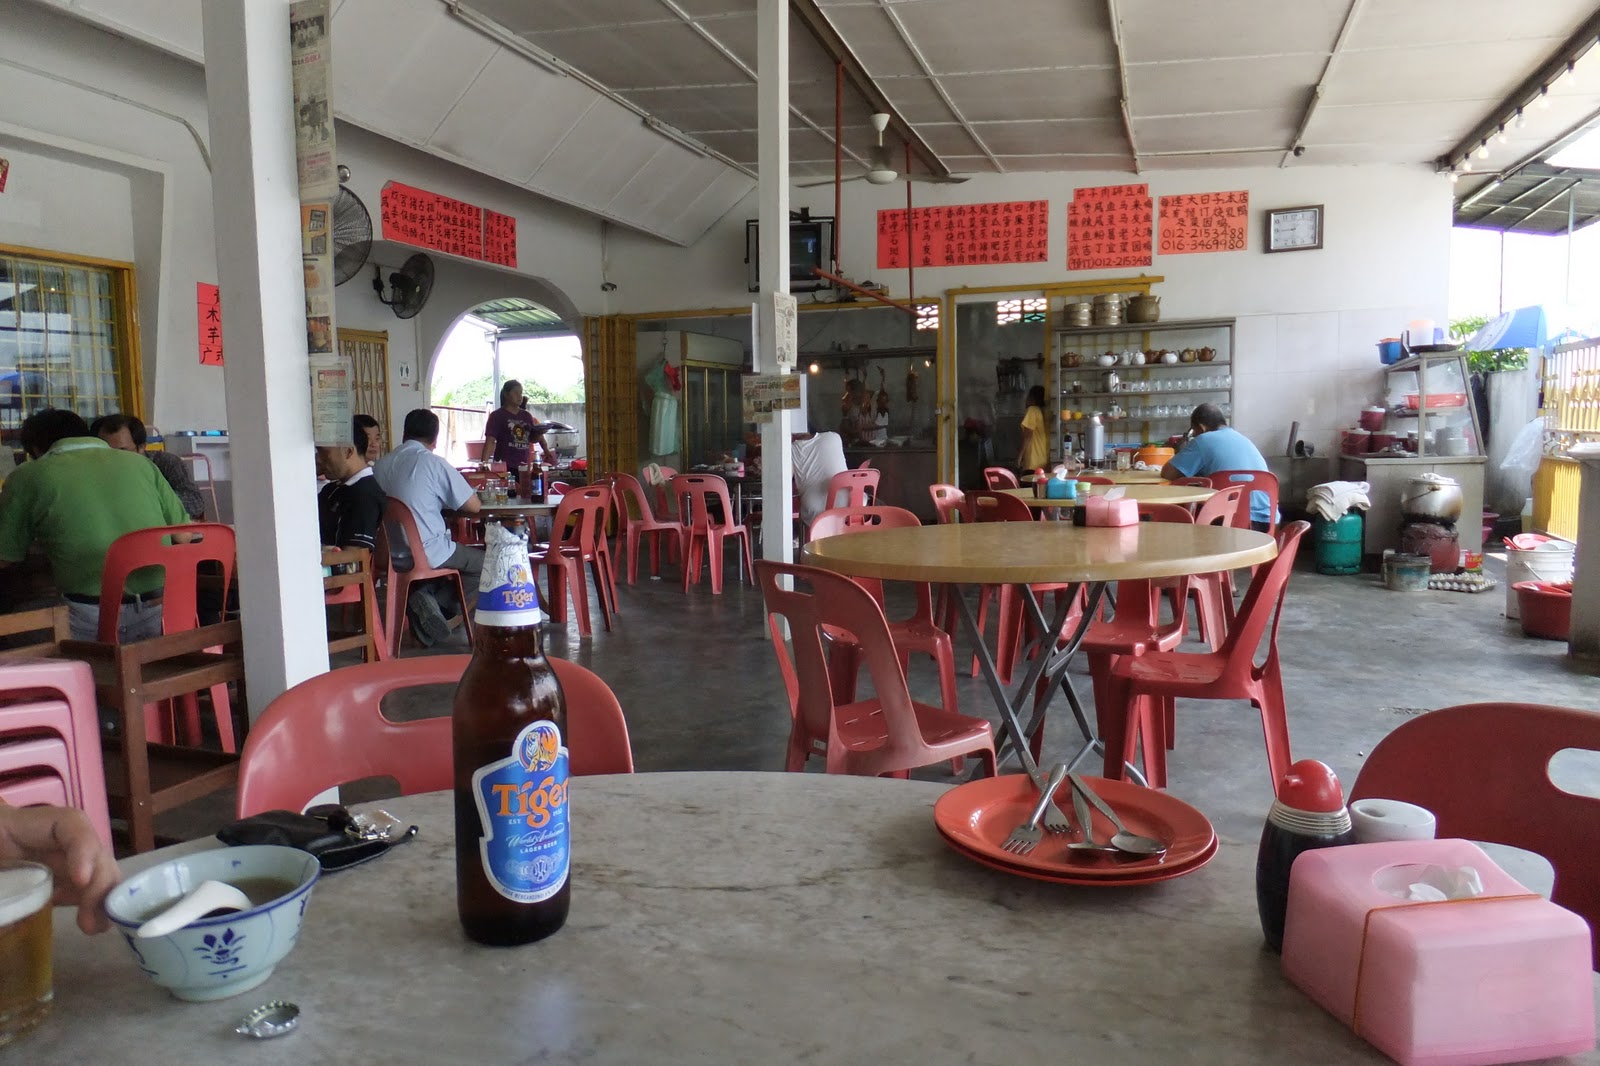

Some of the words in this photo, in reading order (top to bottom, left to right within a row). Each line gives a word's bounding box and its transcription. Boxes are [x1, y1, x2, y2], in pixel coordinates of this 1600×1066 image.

[1162, 227, 1244, 240] 012-2153488
[1161, 238, 1244, 251] 016-3469980
[502, 588, 534, 608] Tiger
[492, 776, 569, 828] Tiger
[520, 845, 542, 854] LAGER
[543, 840, 558, 850] BEER
